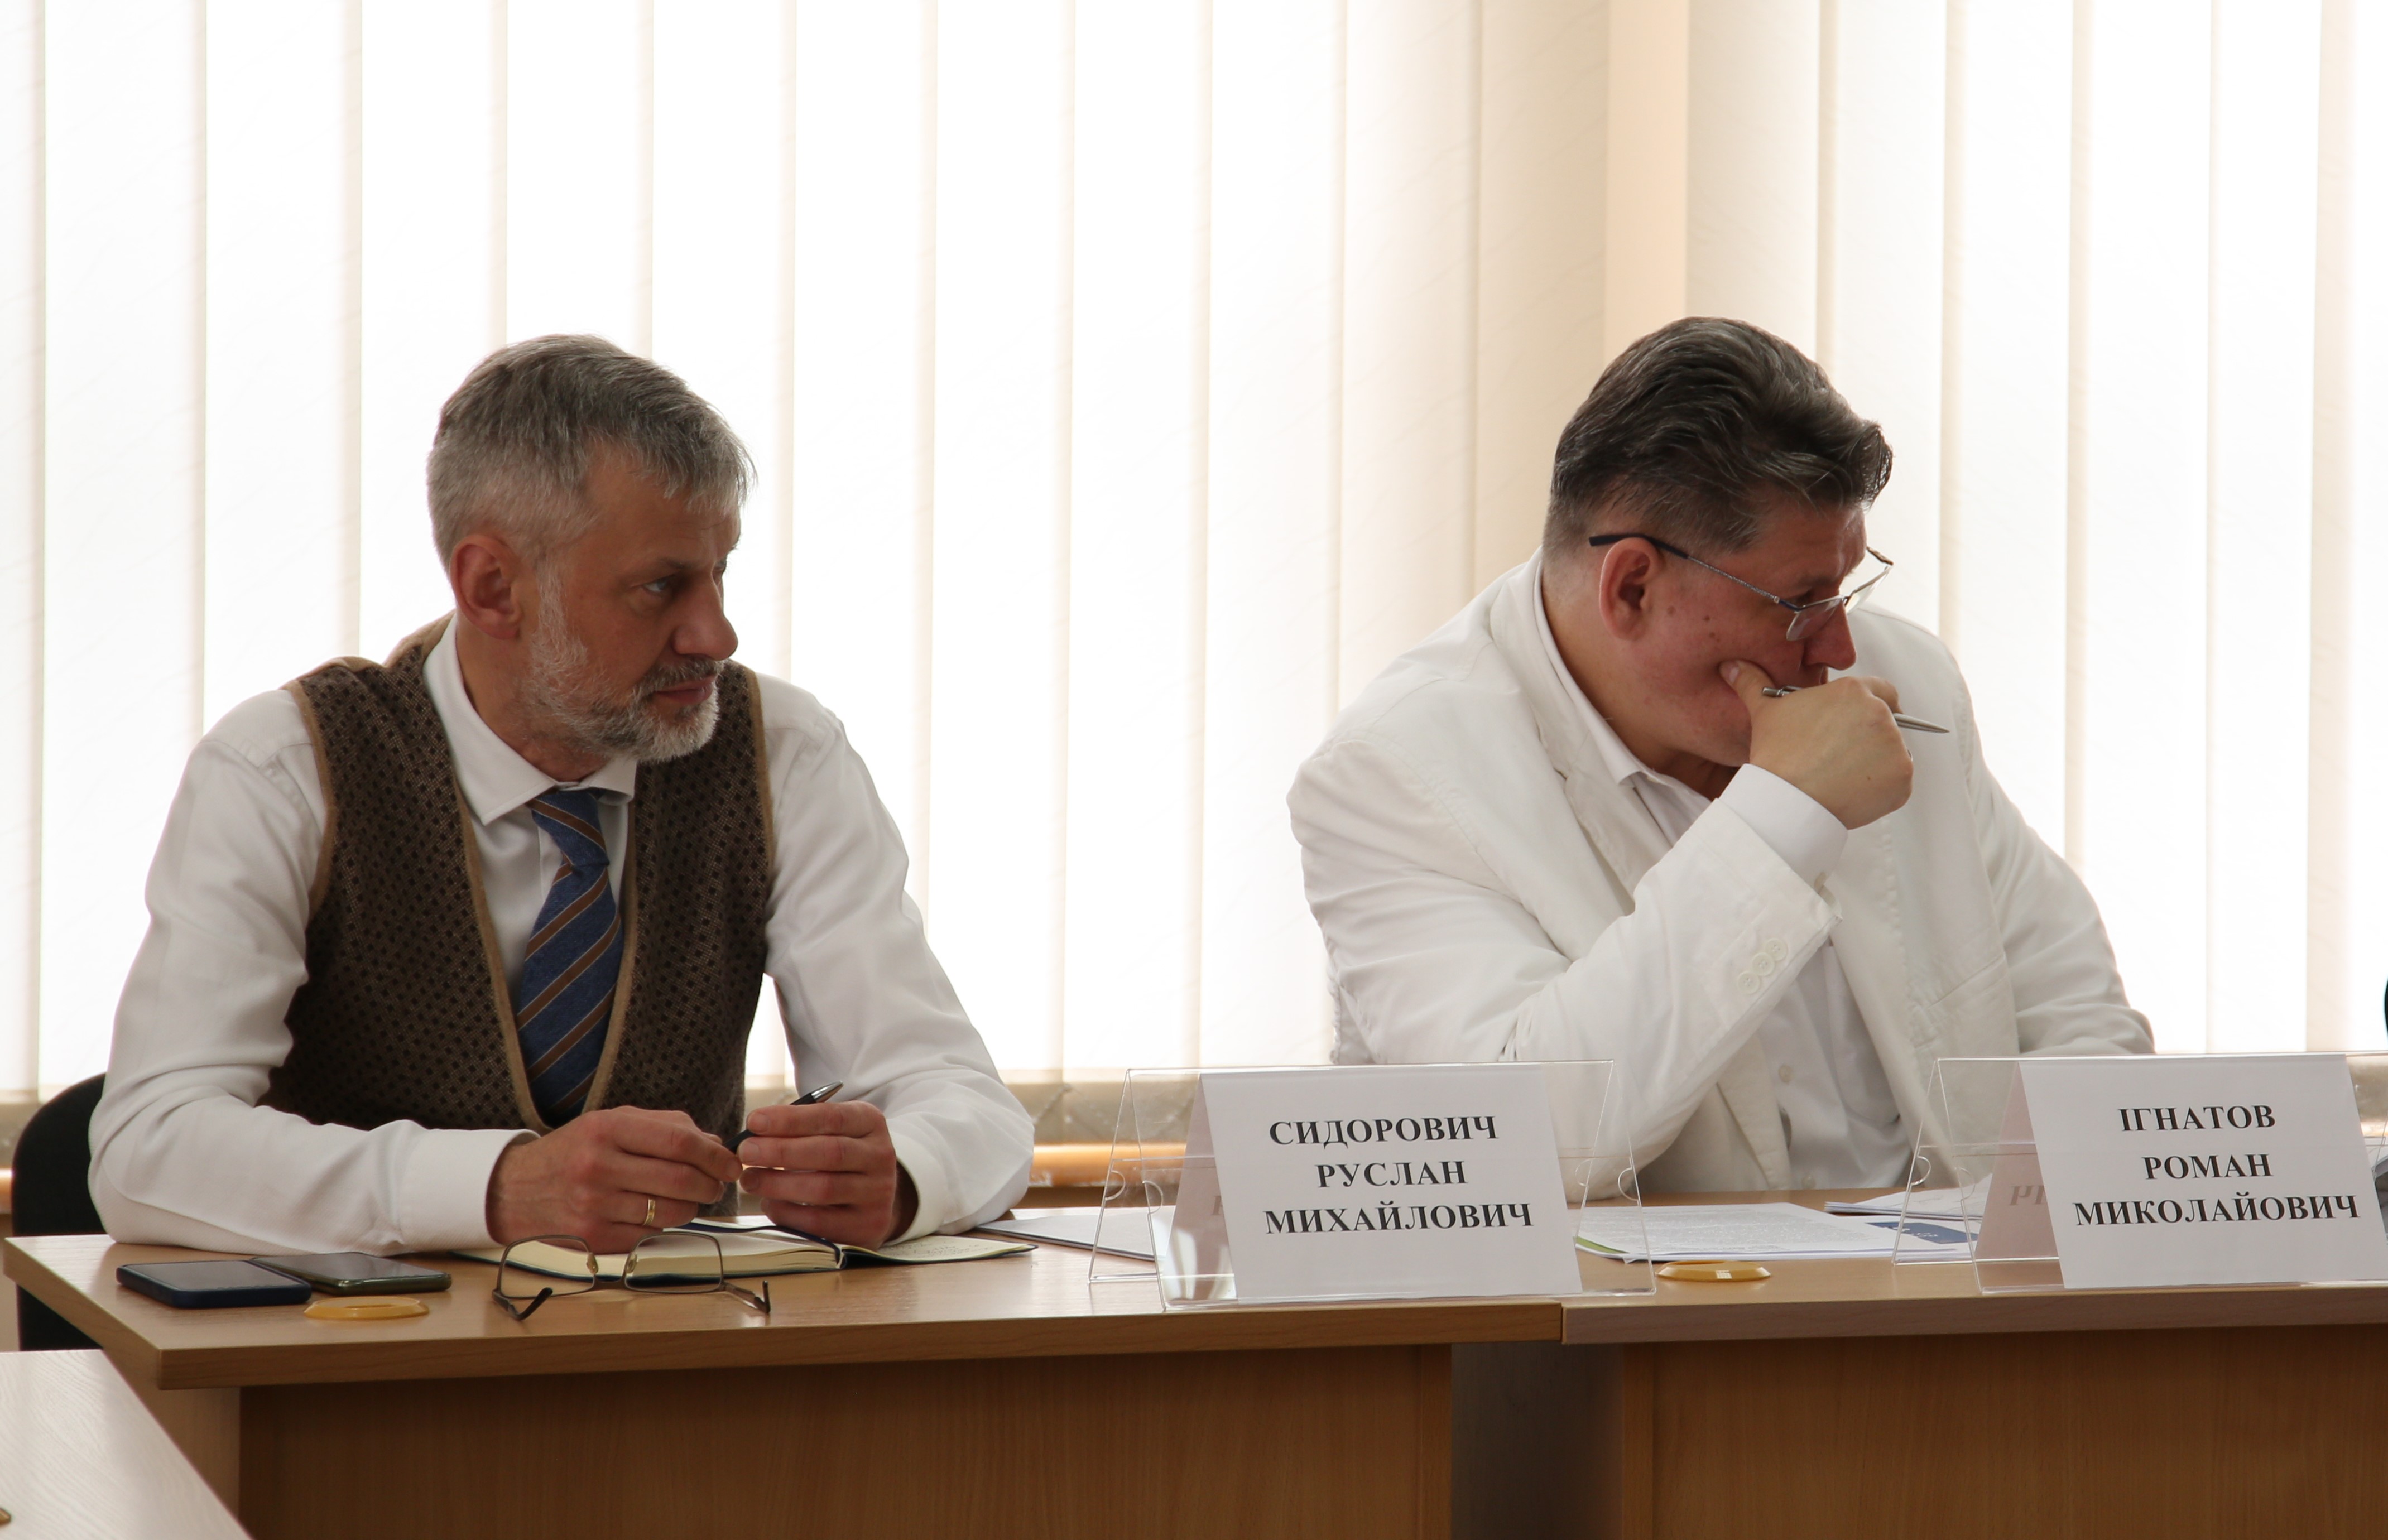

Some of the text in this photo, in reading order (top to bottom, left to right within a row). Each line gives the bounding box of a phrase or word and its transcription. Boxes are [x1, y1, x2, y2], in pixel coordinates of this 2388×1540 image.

[1269, 1116, 1499, 1149] СИДОРОВИЧ
[2118, 1105, 2276, 1132] ІГНАТОВ
[1316, 1160, 1468, 1188] РУСЛАН
[2142, 1153, 2274, 1180] РОМАН
[1264, 1200, 1534, 1235] МИХАЙЛОВИЧ
[2072, 1192, 2360, 1226] МИКОЛАЙОВИЧ
